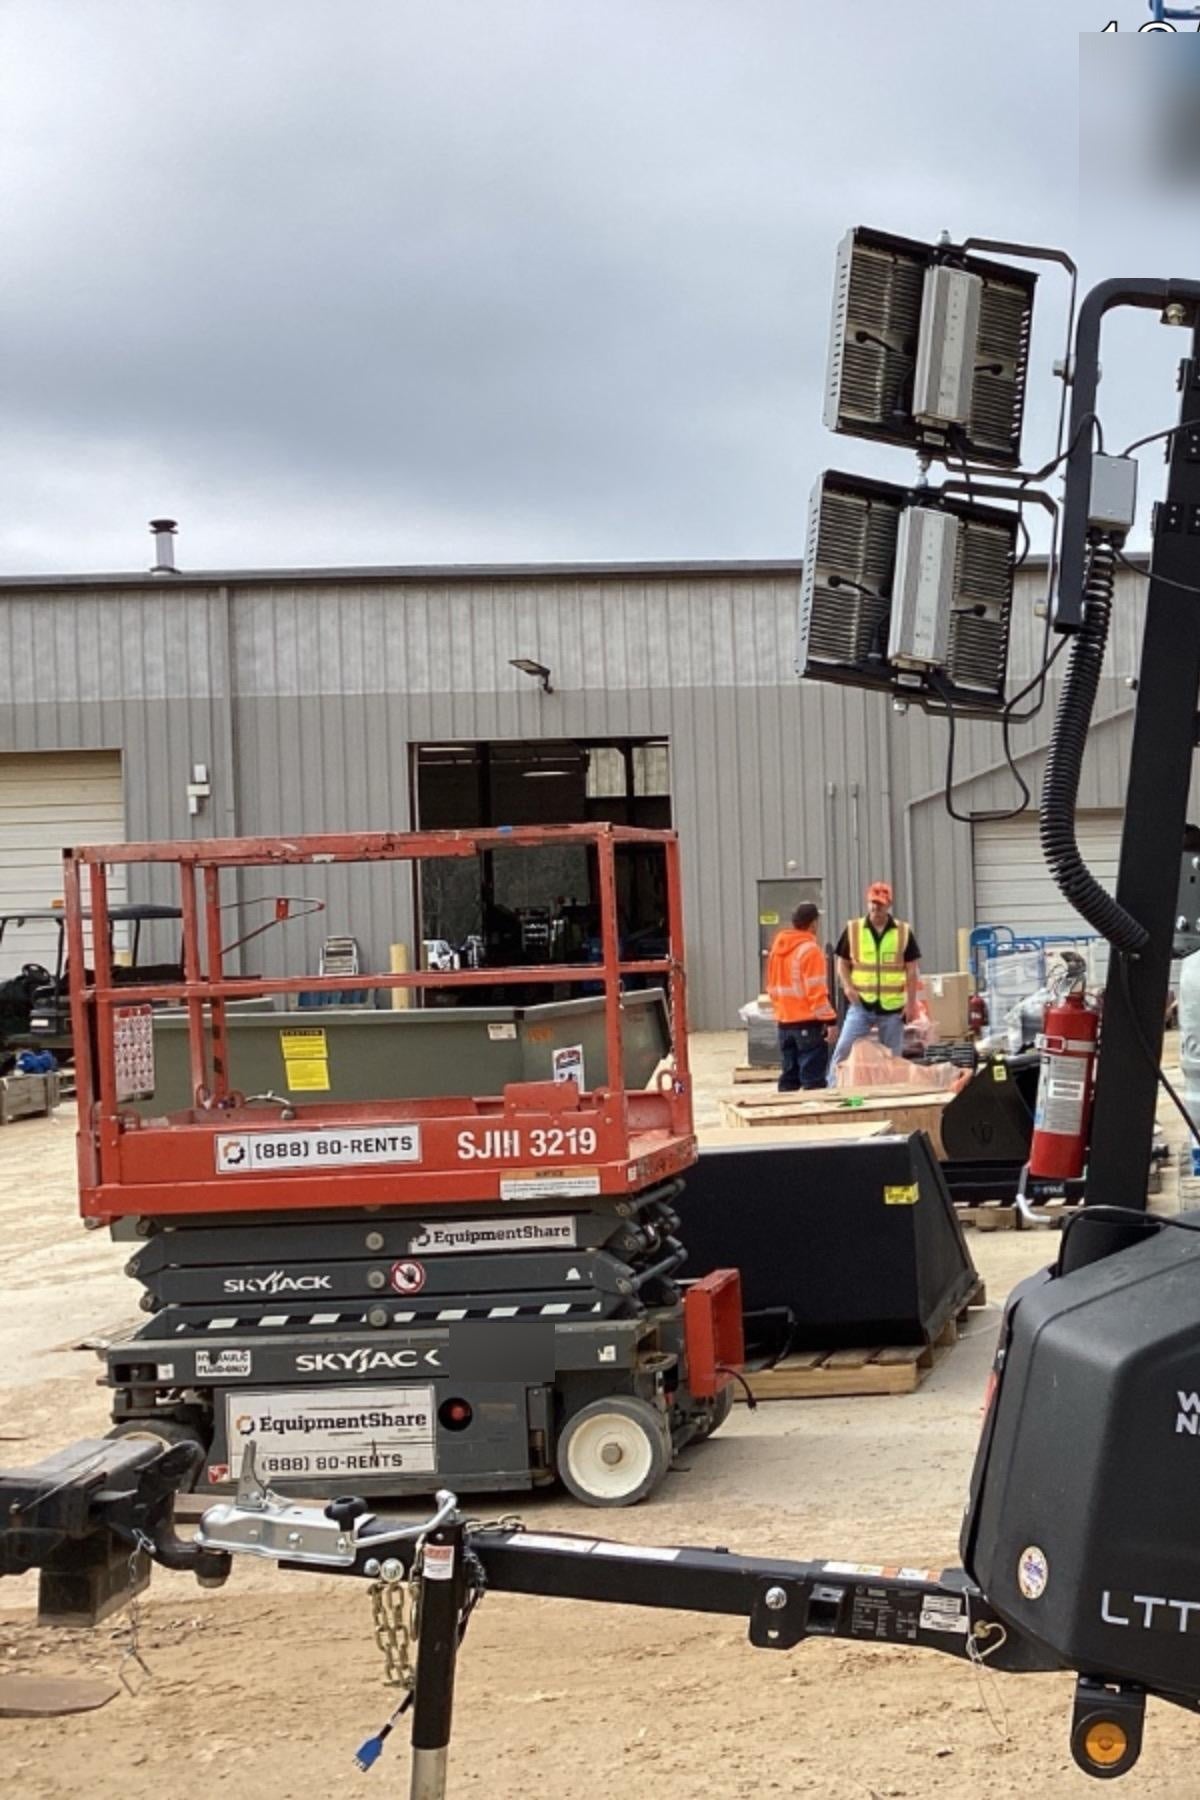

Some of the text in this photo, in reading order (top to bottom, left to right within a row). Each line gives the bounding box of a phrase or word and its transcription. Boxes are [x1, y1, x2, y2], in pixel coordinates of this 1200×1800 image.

[255, 1140, 310, 1160] (888)
[529, 1127, 598, 1157] 3219
[433, 1224, 571, 1246] EquipmentShare
[223, 1270, 332, 1294] SKYJACK
[258, 1412, 427, 1435] EquipmentShare
[261, 1453, 404, 1472] (888) 80-RENTS
